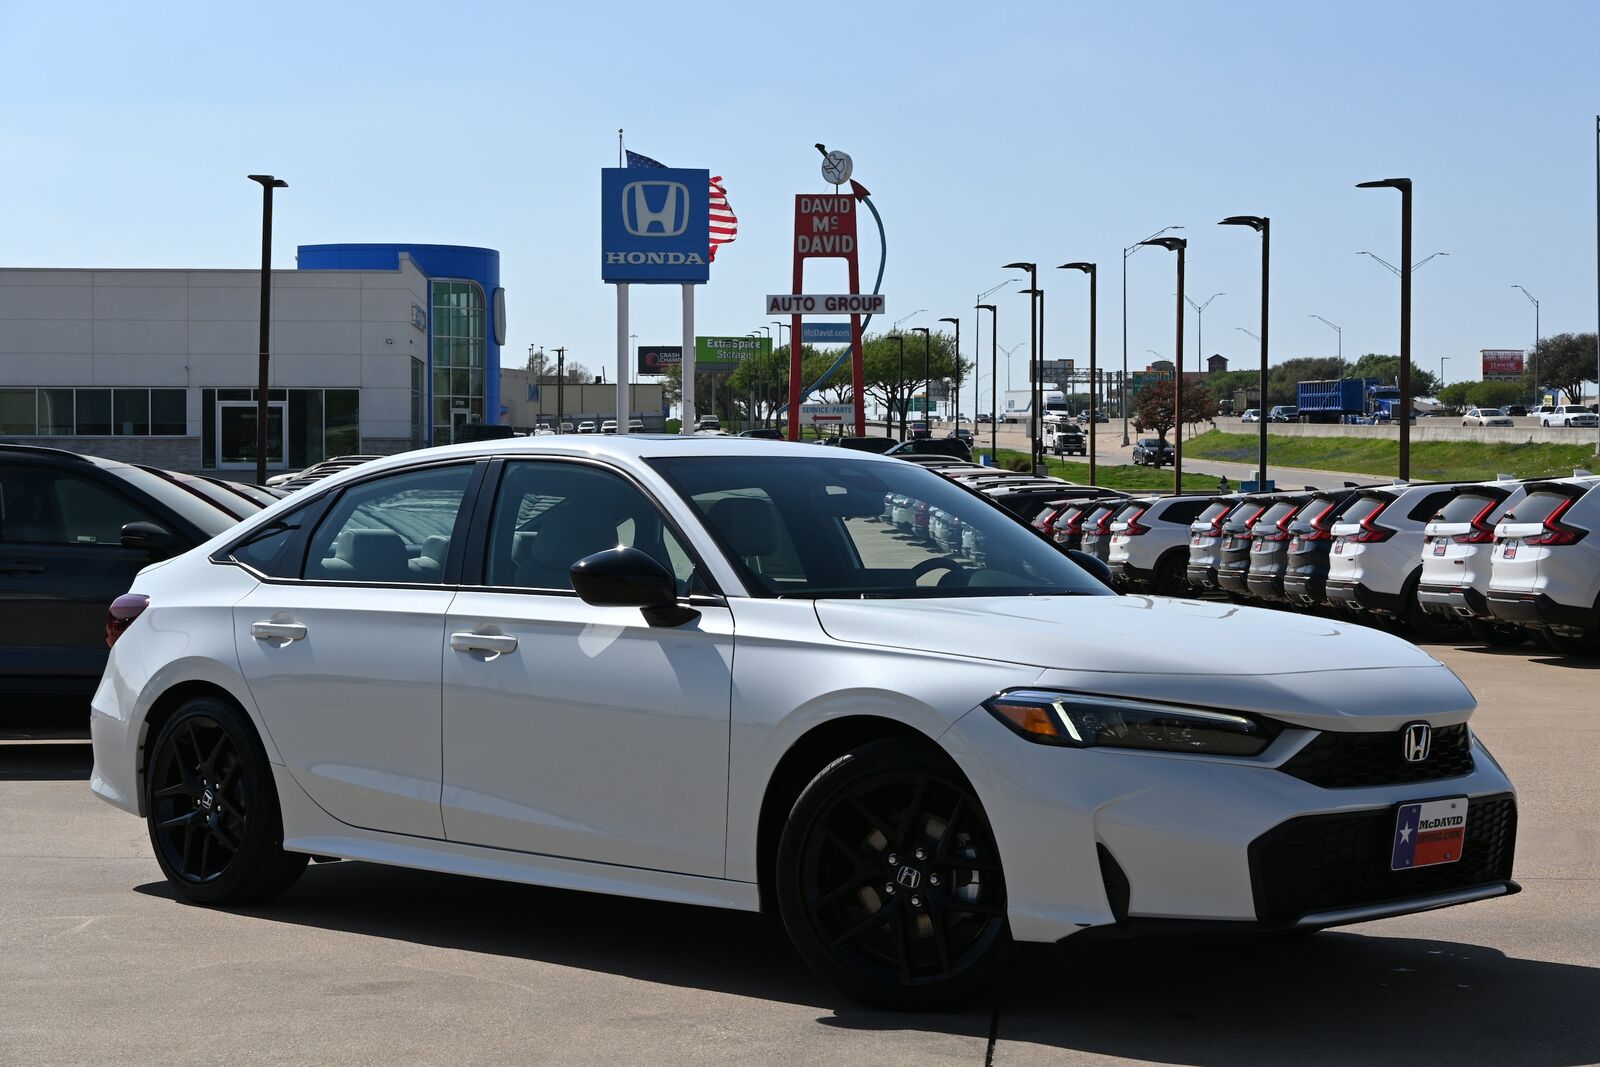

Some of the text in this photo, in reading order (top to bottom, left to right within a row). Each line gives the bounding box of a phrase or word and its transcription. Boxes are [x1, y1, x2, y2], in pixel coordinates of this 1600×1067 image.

[801, 198, 850, 213] DAVID
[797, 235, 854, 253] DAVID
[605, 251, 705, 265] HONDA
[769, 296, 883, 312] AUTO GROUP
[803, 328, 850, 337] McDavid.com
[707, 338, 761, 350] Extra Space
[717, 350, 752, 360] Storage
[801, 406, 852, 414] SERVICE/PARTS
[1418, 815, 1463, 830] McDAVID
